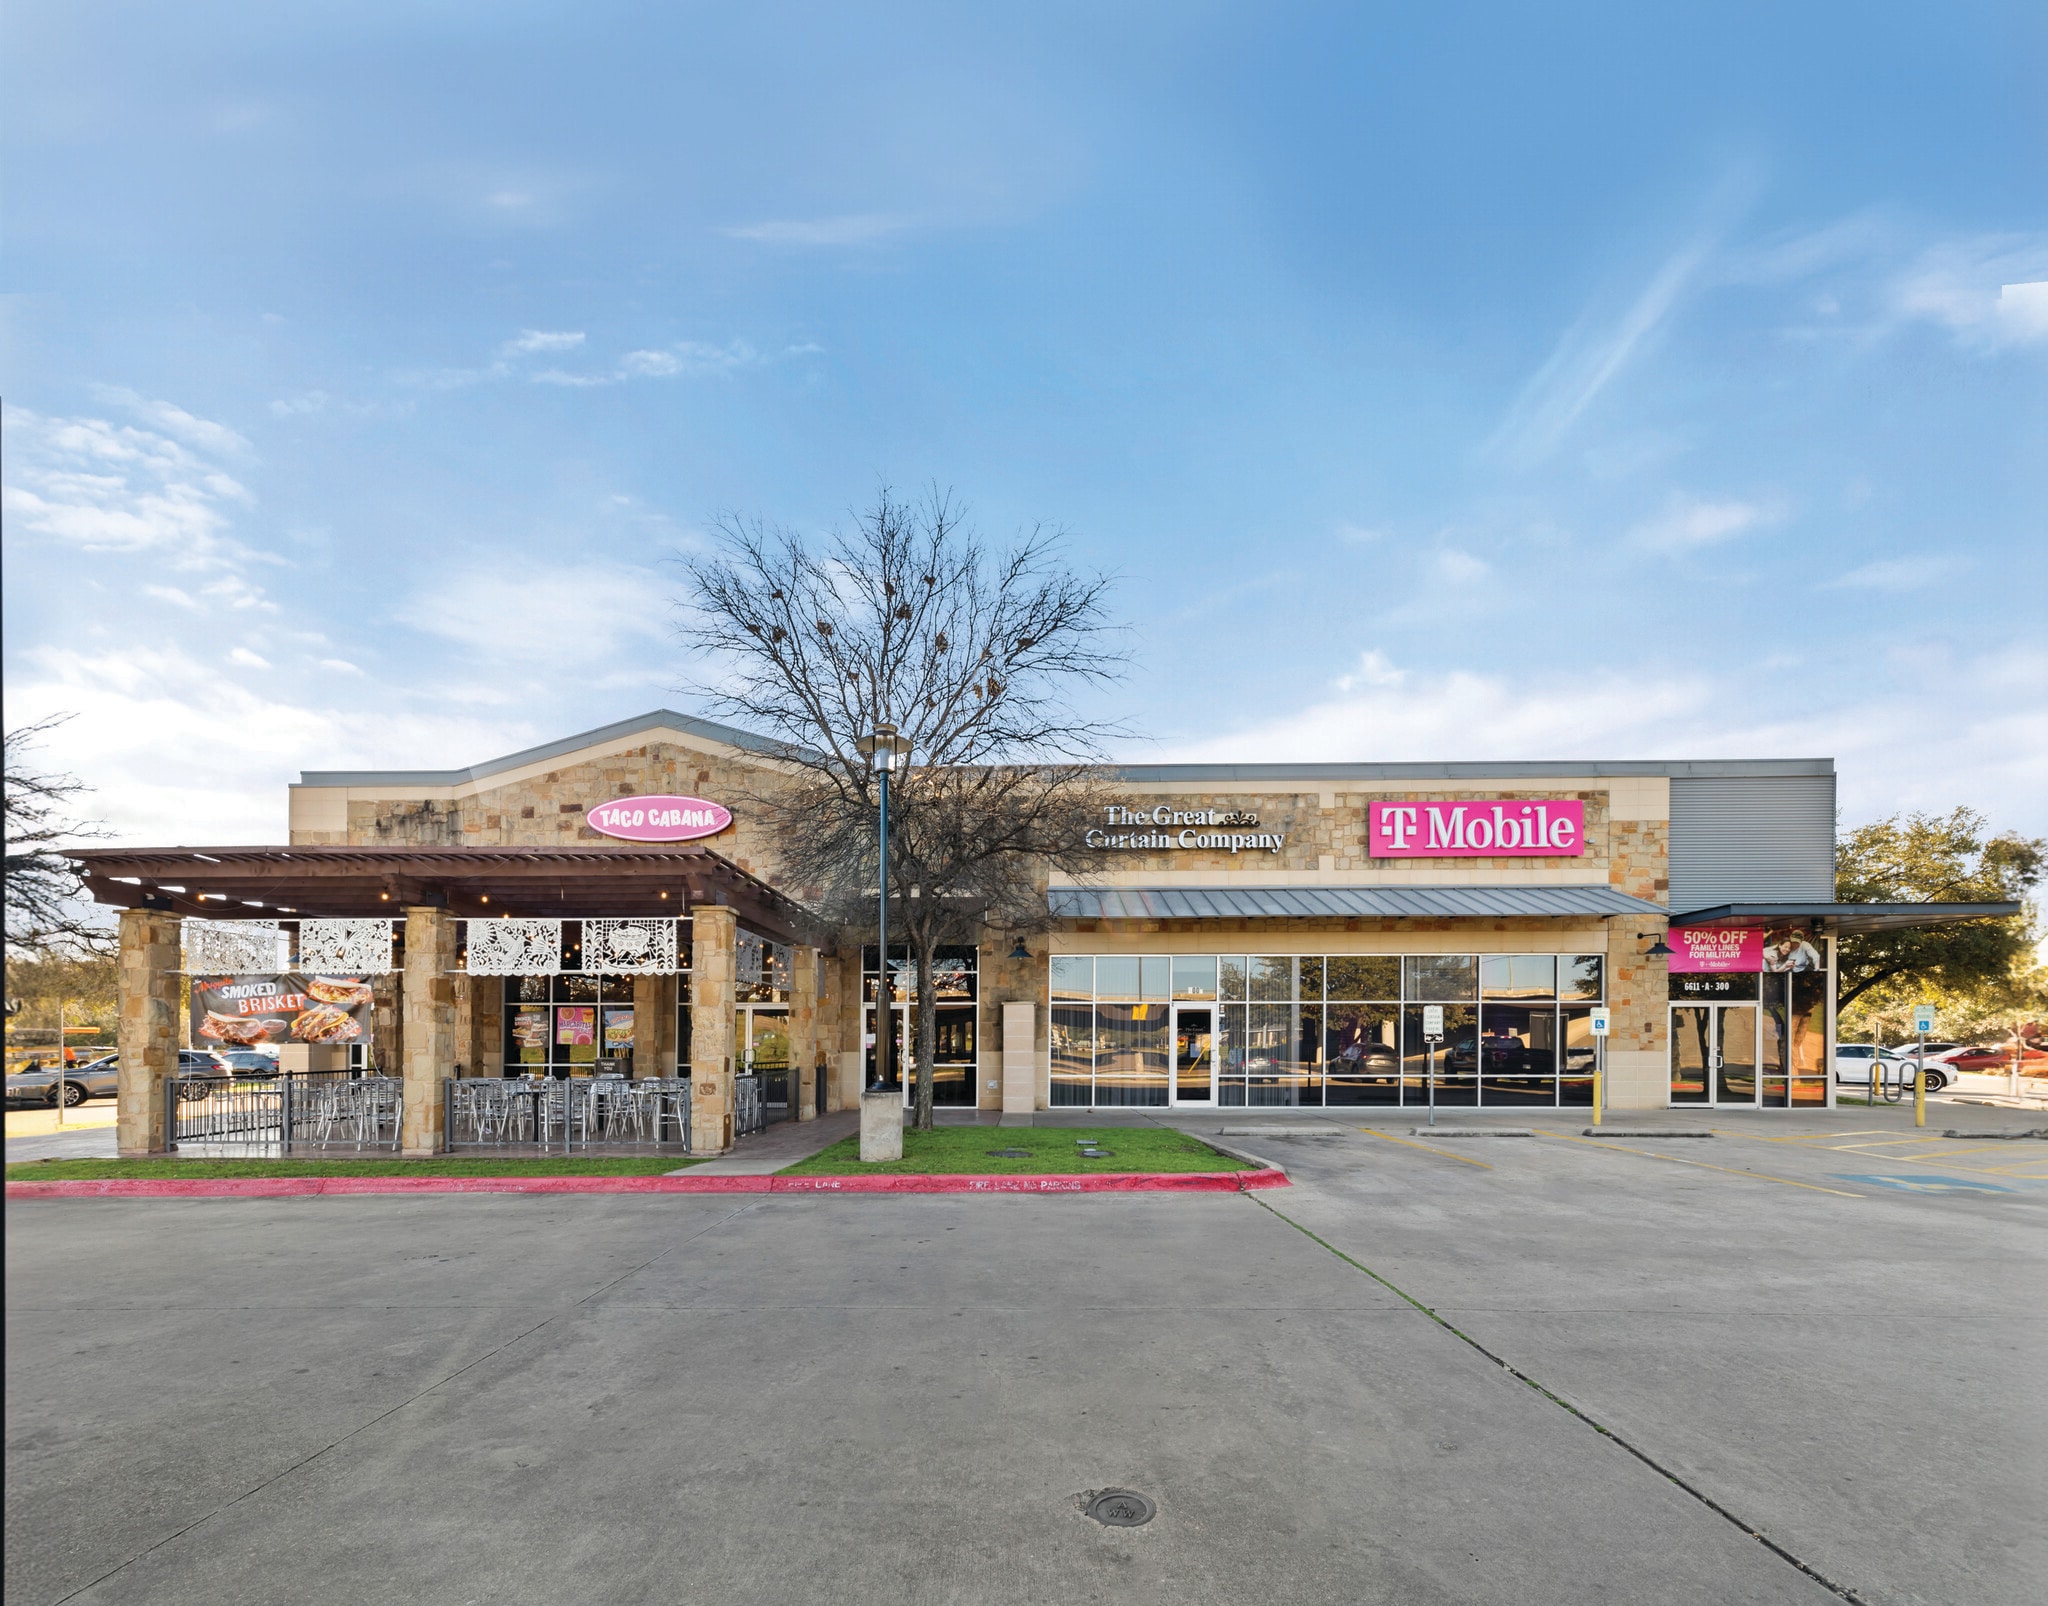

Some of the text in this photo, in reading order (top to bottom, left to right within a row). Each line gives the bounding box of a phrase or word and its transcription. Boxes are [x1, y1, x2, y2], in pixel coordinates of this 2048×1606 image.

[600, 808, 715, 828] TACO CABANA
[1103, 805, 1216, 826] The Great
[1424, 806, 1575, 849] Mobile
[1085, 829, 1285, 854] Curtain Company
[1683, 931, 1748, 944] 50% OFF
[1689, 951, 1741, 959] FOR MILITARY
[221, 982, 277, 1000] SMOKED
[238, 993, 304, 1013] BRISKET
